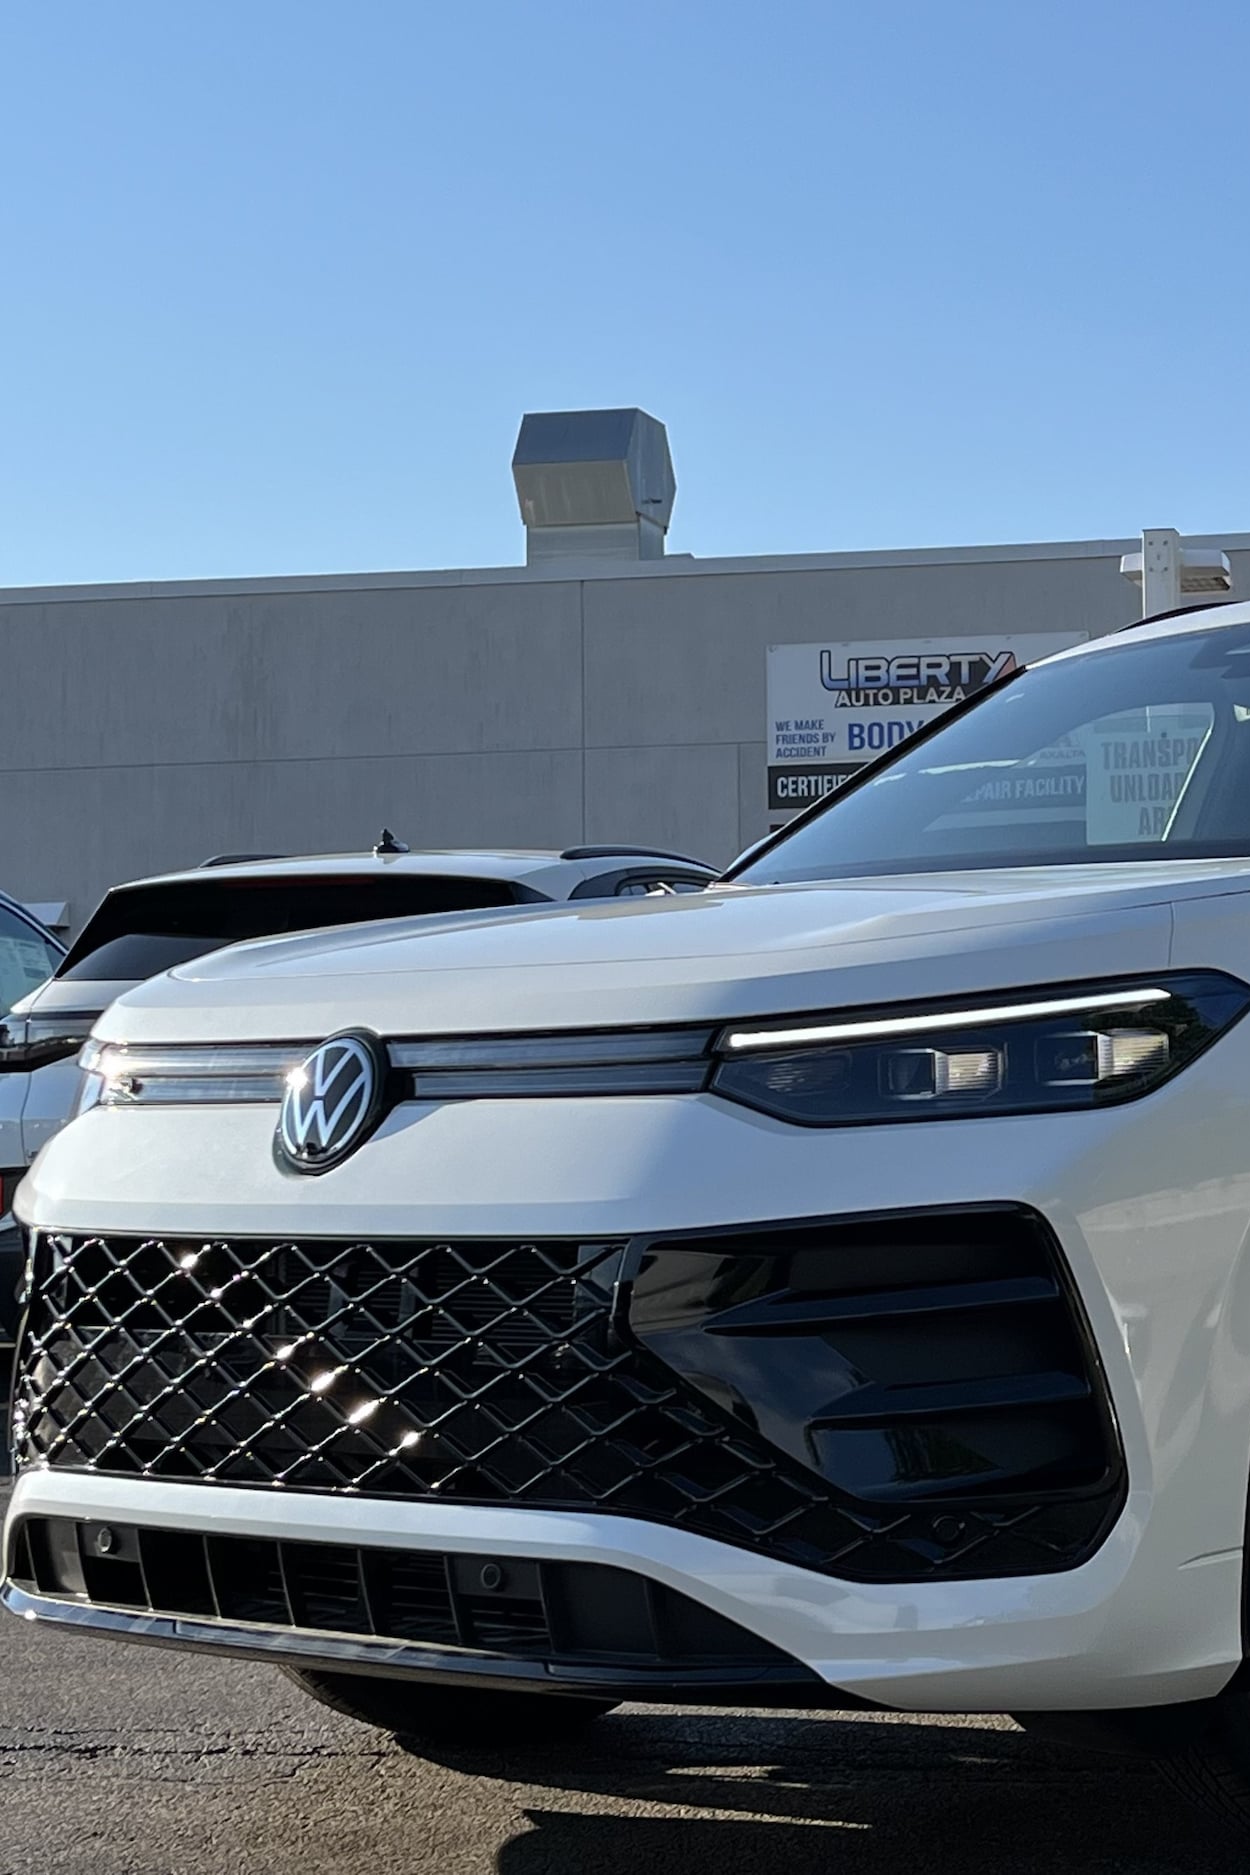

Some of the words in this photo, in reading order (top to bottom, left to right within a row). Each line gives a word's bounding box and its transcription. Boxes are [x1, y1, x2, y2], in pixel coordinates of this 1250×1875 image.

[820, 650, 1016, 691] LIBERTY
[837, 688, 893, 707] AUTO
[899, 686, 968, 704] PLAZA
[775, 721, 792, 732] WE
[794, 719, 825, 731] MAKE
[775, 732, 820, 745] FRIENDS
[822, 731, 836, 743] BY
[775, 746, 828, 759] ACCIDENT
[777, 774, 852, 798] CERTIFI
[1015, 775, 1085, 800] FACILITY
[1138, 806, 1172, 836] AR
